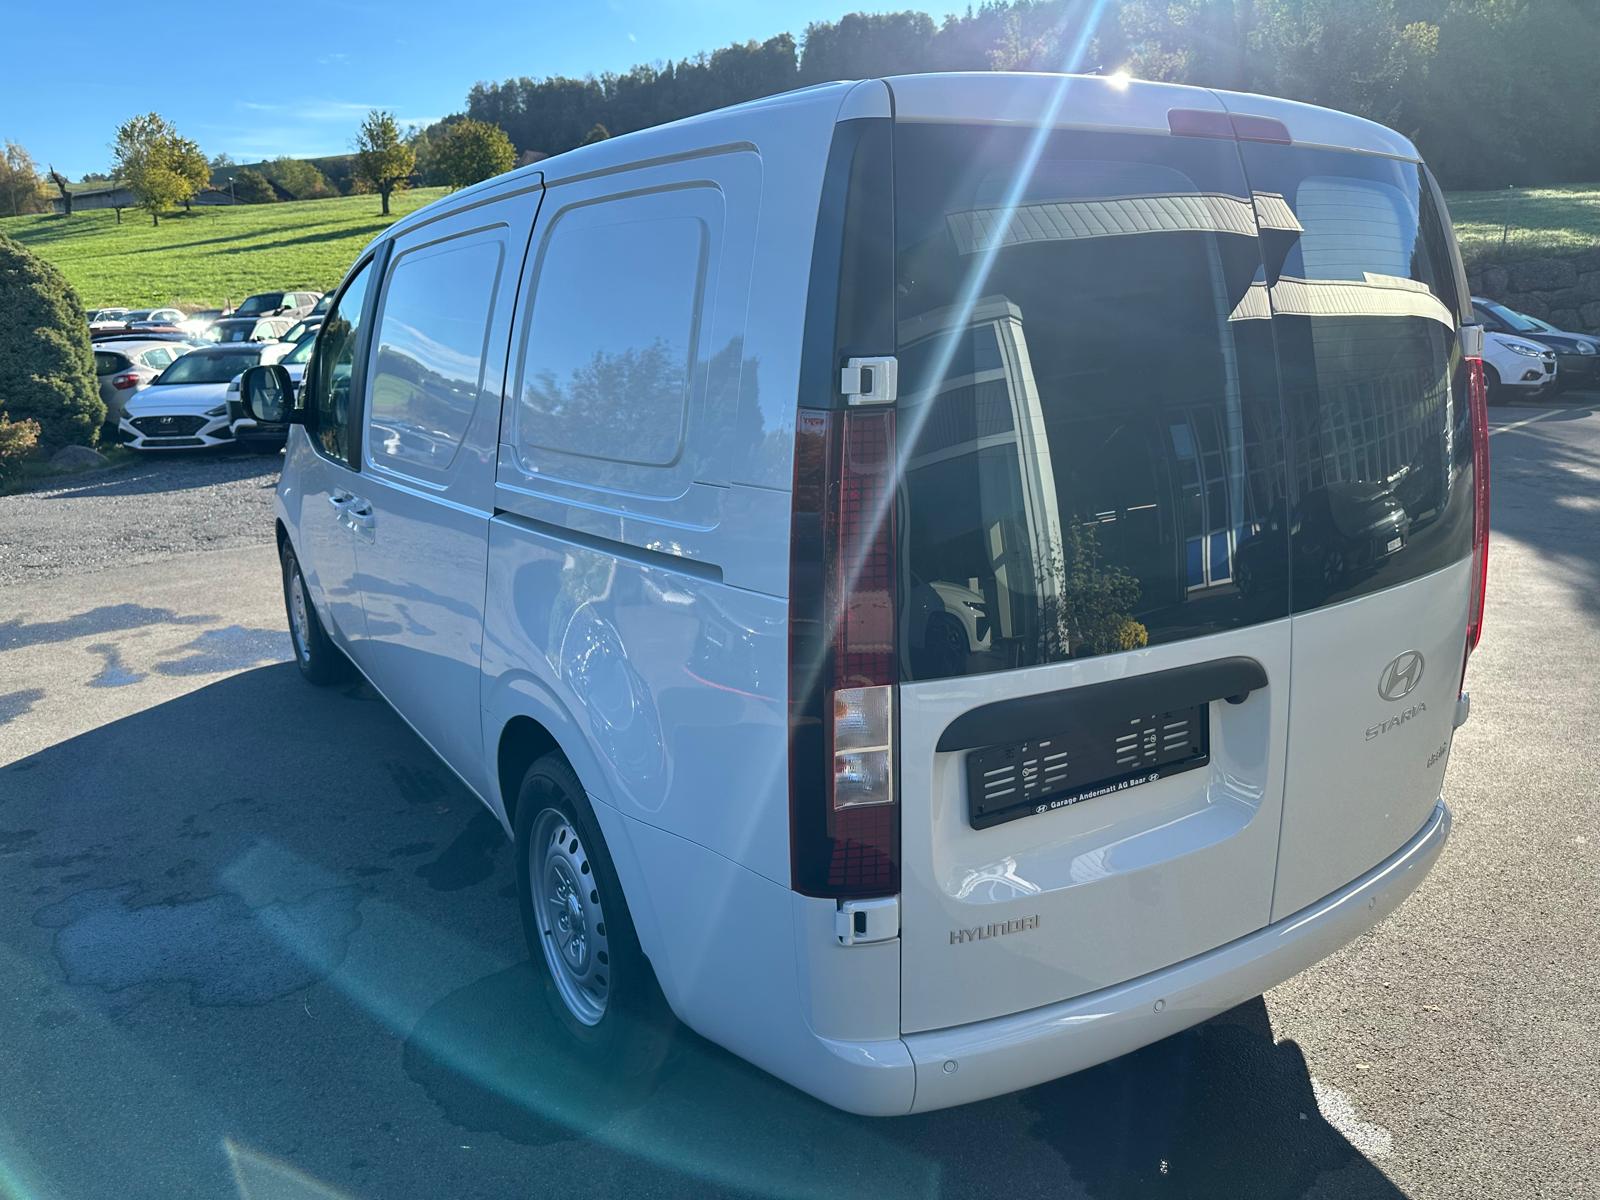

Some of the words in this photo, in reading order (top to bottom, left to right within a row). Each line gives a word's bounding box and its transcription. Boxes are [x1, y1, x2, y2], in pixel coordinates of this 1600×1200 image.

[1364, 702, 1427, 741] STARIA
[1050, 797, 1078, 809] Garage
[1079, 785, 1117, 801] Andermatt
[1118, 781, 1129, 791] AG
[1129, 776, 1147, 787] Baar
[950, 914, 1041, 945] HYUNDAI
